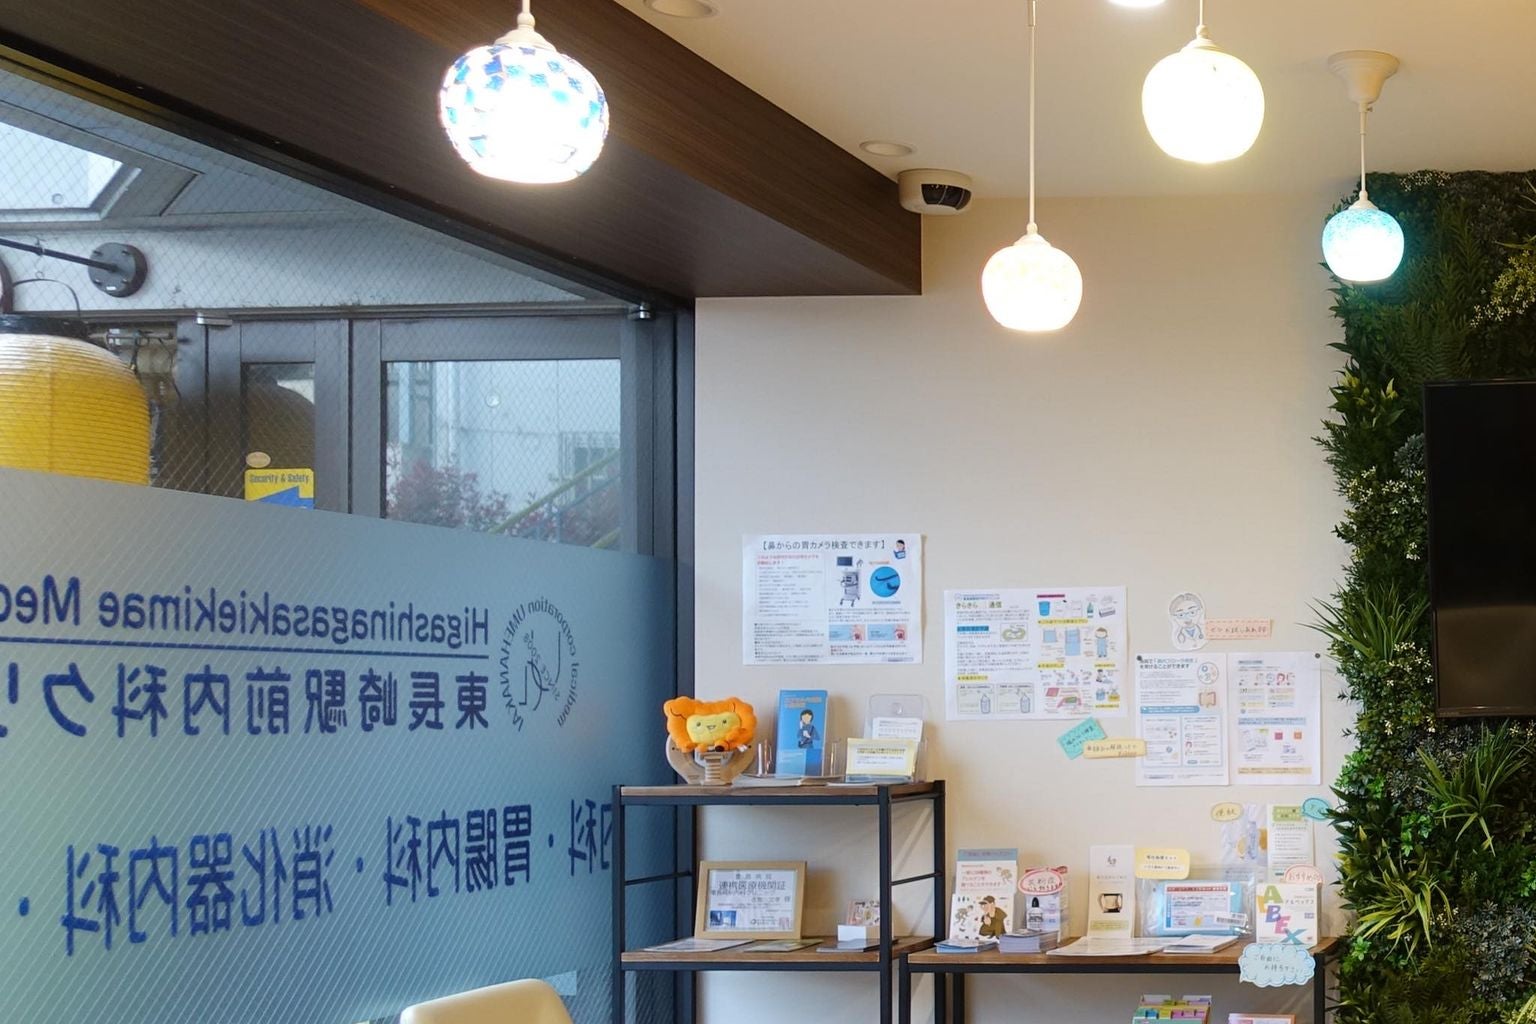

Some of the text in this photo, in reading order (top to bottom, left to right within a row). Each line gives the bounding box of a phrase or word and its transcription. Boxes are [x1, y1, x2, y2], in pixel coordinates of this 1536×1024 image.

[250, 473, 309, 484] Security & Safety
[763, 540, 885, 551] 【鼻からの胃カメラ検査できます】
